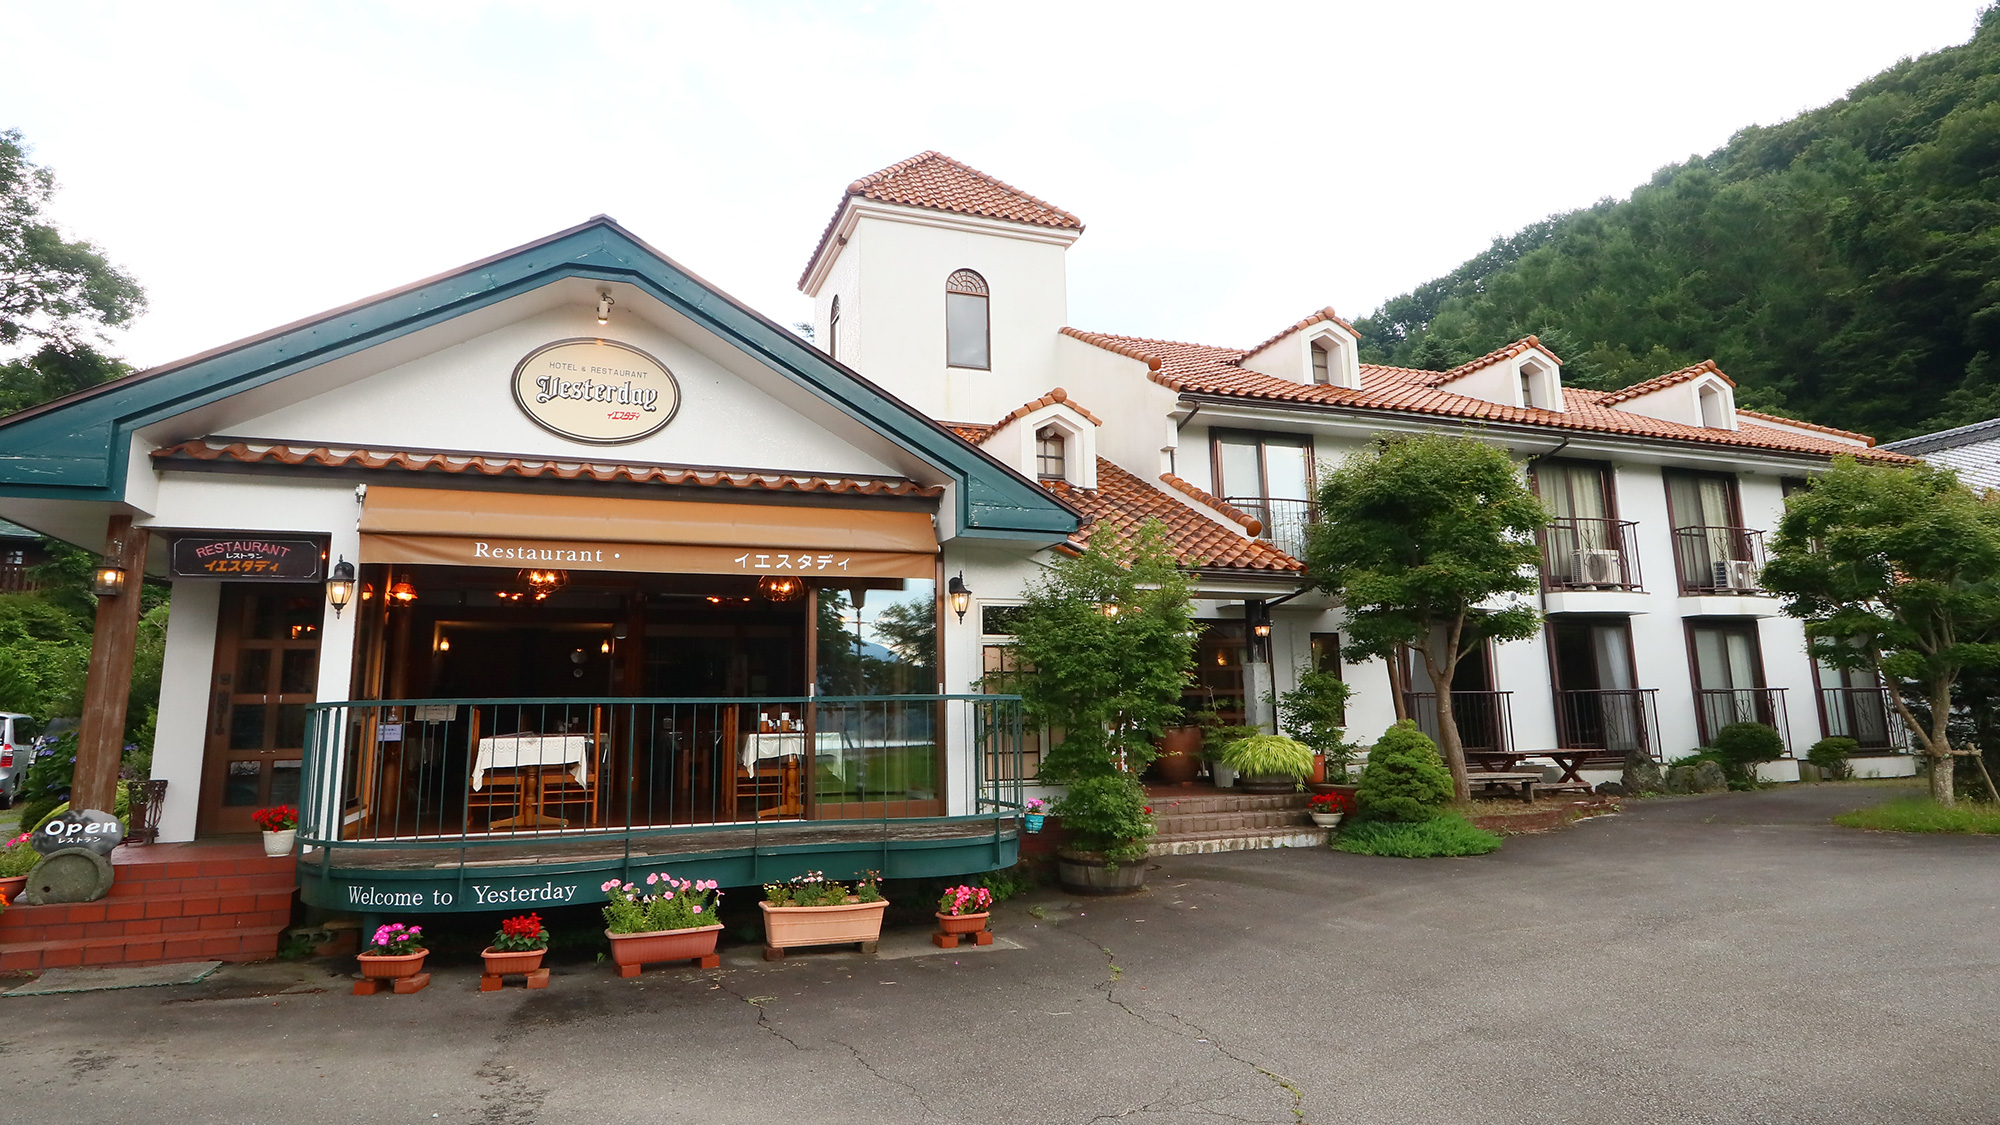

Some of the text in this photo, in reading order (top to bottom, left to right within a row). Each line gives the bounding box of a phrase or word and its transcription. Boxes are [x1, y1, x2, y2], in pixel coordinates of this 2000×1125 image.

[549, 361, 577, 372] HOTEL
[591, 366, 648, 379] RESTAURANT
[535, 374, 658, 413] Yesterday
[195, 541, 291, 558] RESTAURANT
[474, 542, 603, 563] Restaurant
[204, 560, 280, 572] イエスタディ
[734, 552, 851, 571] イエスタディ
[45, 820, 117, 837] Open
[58, 836, 101, 844] レストラン
[348, 882, 577, 906] Welcome to Yesterday
